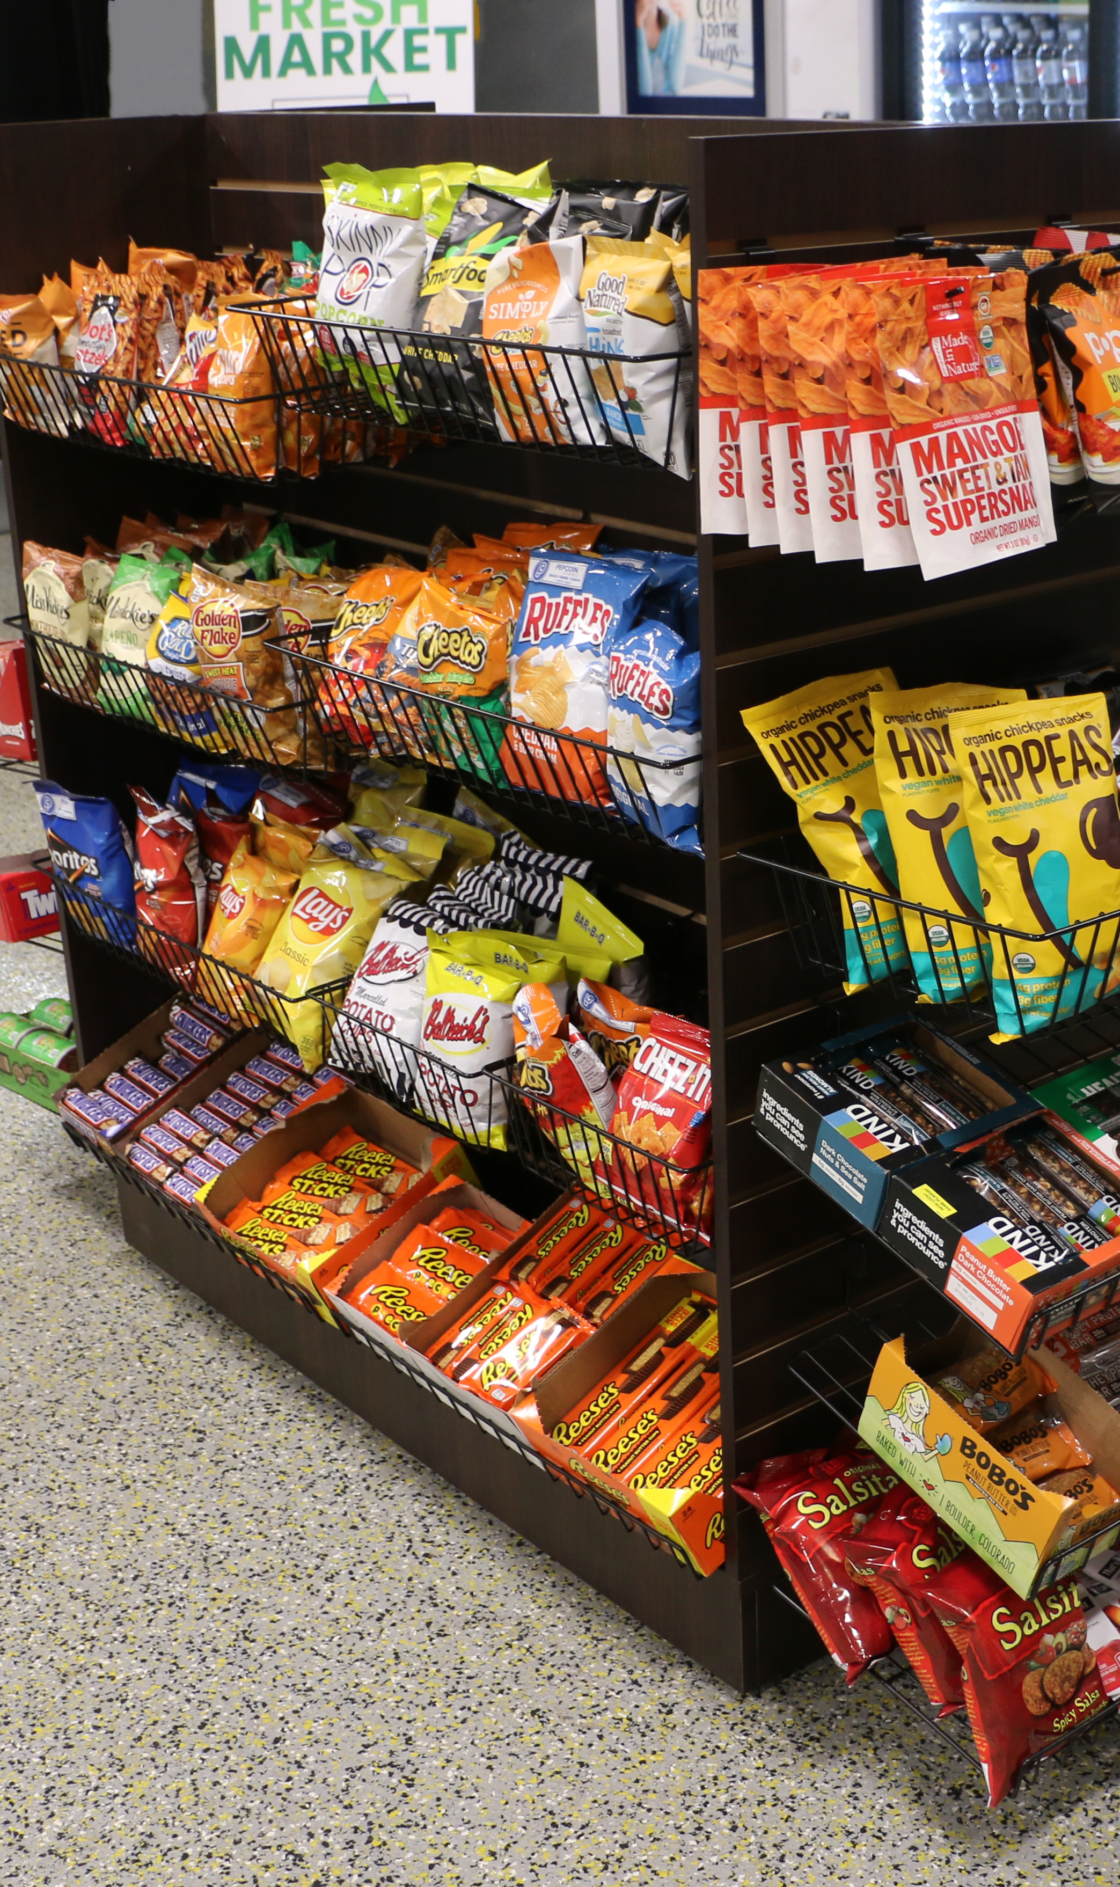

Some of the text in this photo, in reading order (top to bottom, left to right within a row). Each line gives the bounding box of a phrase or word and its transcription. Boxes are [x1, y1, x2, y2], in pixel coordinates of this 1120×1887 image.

[224, 26, 467, 80] MARKET
[583, 288, 627, 316] Natured
[597, 271, 626, 297] Good
[488, 300, 549, 321] SIMPLY
[941, 332, 970, 349] Made
[946, 361, 980, 378] Nature
[919, 461, 1009, 507] SWEET &
[970, 520, 1018, 546] ORGANIC DRIED
[194, 608, 238, 629] Golden
[200, 629, 238, 647] Flake
[520, 593, 613, 643] RUFFLES
[417, 621, 487, 674] Cheetos
[222, 666, 238, 676] HEAT
[608, 652, 674, 719] RUFFLES
[761, 682, 884, 740] organic chickpea snacks
[883, 711, 923, 725] organic
[963, 710, 1094, 747] organic chickpea snacks
[796, 757, 875, 799] vegan white cheddar
[901, 775, 962, 791] vegan white
[968, 724, 1115, 806] HIPPEAS
[986, 792, 1068, 818] vegan white cheddar
[291, 887, 351, 933] Lay's
[574, 911, 606, 946] BAR-B-Q
[446, 963, 484, 987] BAR-B-Q
[494, 951, 529, 974] BAR-B-Q
[1016, 977, 1072, 995] 4g proten
[1017, 992, 1058, 1008] 3g fiber
[341, 999, 396, 1032] POTATO
[840, 1064, 875, 1091] KIND
[885, 1052, 918, 1077] KIND
[759, 1106, 806, 1152] & pronounce
[761, 1098, 805, 1142] you can see
[762, 1088, 804, 1132] ingredients
[846, 1103, 911, 1154] KIND
[334, 1158, 393, 1179] STICKS
[820, 1147, 867, 1192] Nuts & Sea Salt
[821, 1139, 869, 1184] Dark Chocolate
[292, 1177, 350, 1198] STICKS
[262, 1207, 320, 1229] STICKS
[537, 1203, 590, 1260] Reese's
[893, 1208, 945, 1259] you can see
[894, 1198, 945, 1248] ingredients
[569, 1223, 623, 1280] Reese's
[889, 1218, 946, 1270] & pronounce
[987, 1215, 1055, 1270] KIND
[957, 1253, 976, 1275] Dark
[975, 1270, 1015, 1307] Chocolate
[960, 1245, 987, 1273] Peanut
[986, 1268, 1012, 1293] Butter
[664, 1305, 685, 1325] KING
[671, 1308, 691, 1330] SIZE
[1070, 1333, 1094, 1349] BAR
[552, 1380, 620, 1447] Reese's
[590, 1408, 660, 1475] Reese's
[620, 1429, 660, 1471] PEANUT BUTTER CUPS
[875, 1430, 917, 1478] BAKED WITH
[1000, 1423, 1049, 1454] BOBO'S
[629, 1431, 699, 1490] Reese's
[843, 1461, 883, 1478] ORIGINAL
[959, 1434, 1036, 1512] BOBO'S
[569, 1458, 631, 1507] Reese's
[962, 1459, 987, 1488] PEANUT
[985, 1478, 1011, 1509] BUTTER
[682, 1506, 693, 1517] 24
[944, 1502, 1016, 1575] BOULDER, COLORADO
[1052, 1688, 1102, 1733] Spicy Salsa
